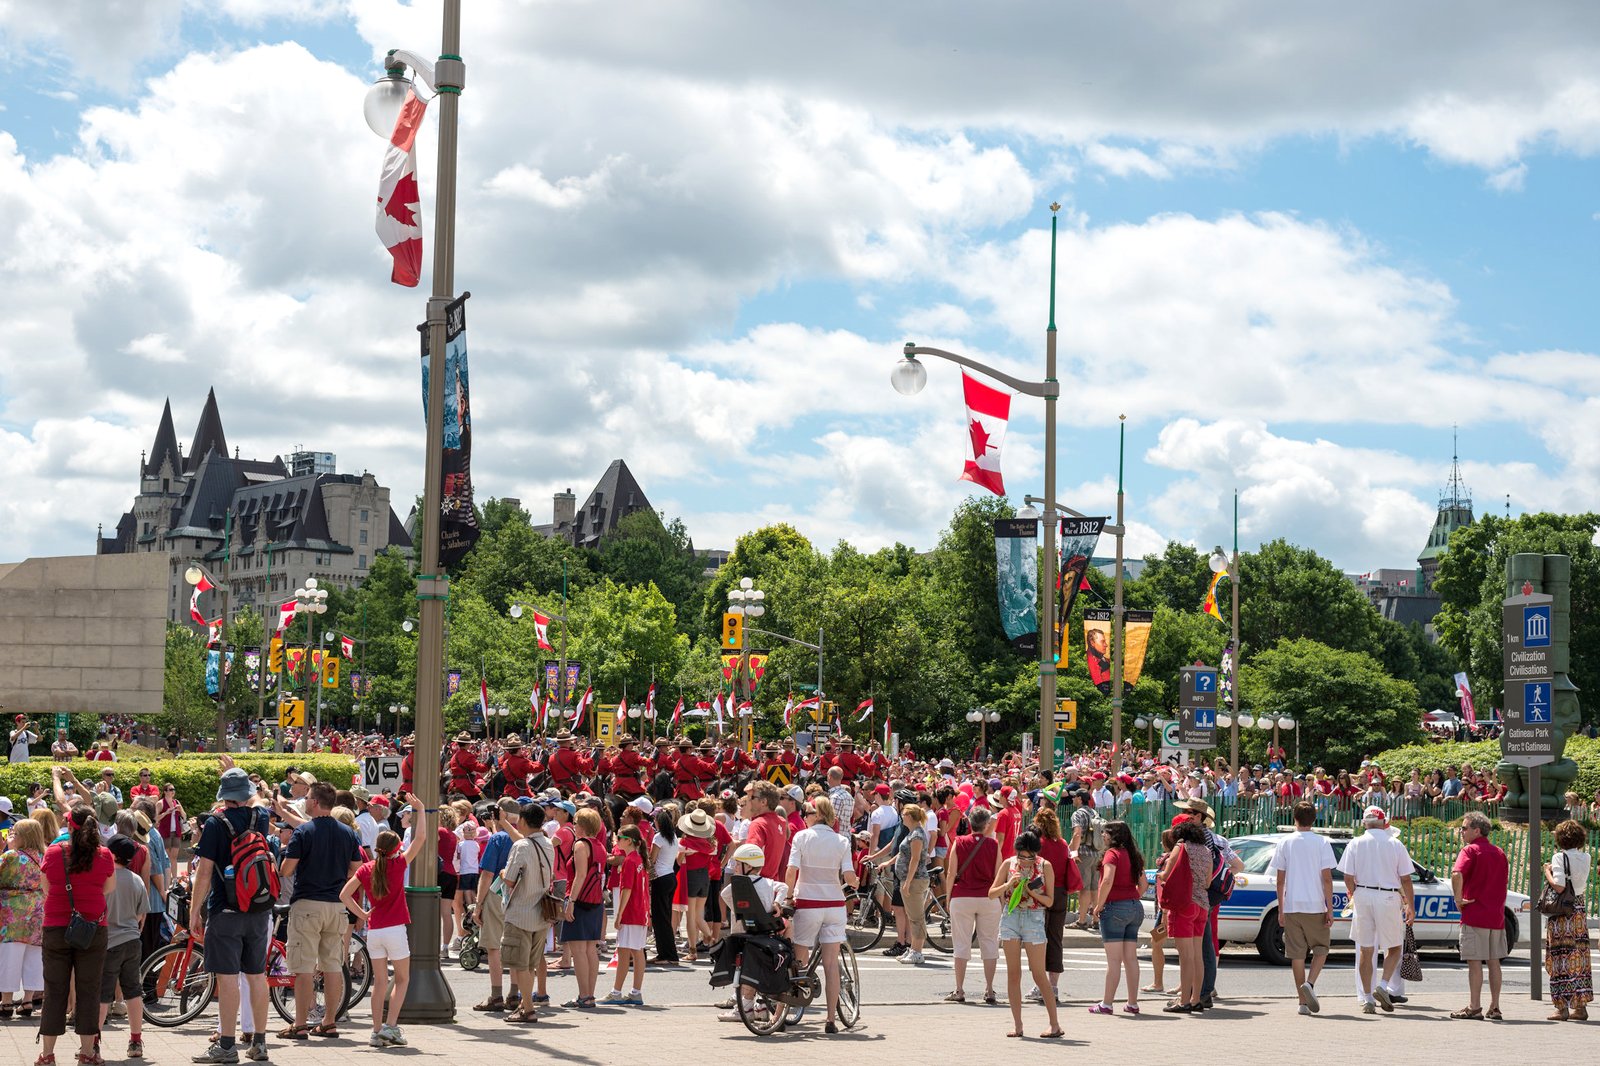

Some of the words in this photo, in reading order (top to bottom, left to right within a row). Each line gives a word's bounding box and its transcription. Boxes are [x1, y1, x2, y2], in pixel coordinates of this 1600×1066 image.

[1073, 526, 1079, 534] of
[1079, 521, 1099, 534] 1812
[441, 530, 460, 539] Charles
[1097, 611, 1110, 621] 1812
[1511, 650, 1546, 662] Civilization
[1510, 664, 1548, 676] Civilisations
[1509, 728, 1535, 738] Gatineau
[1535, 728, 1549, 738] Park
[1507, 742, 1521, 751] Parc
[1525, 742, 1551, 752] Gatineau
